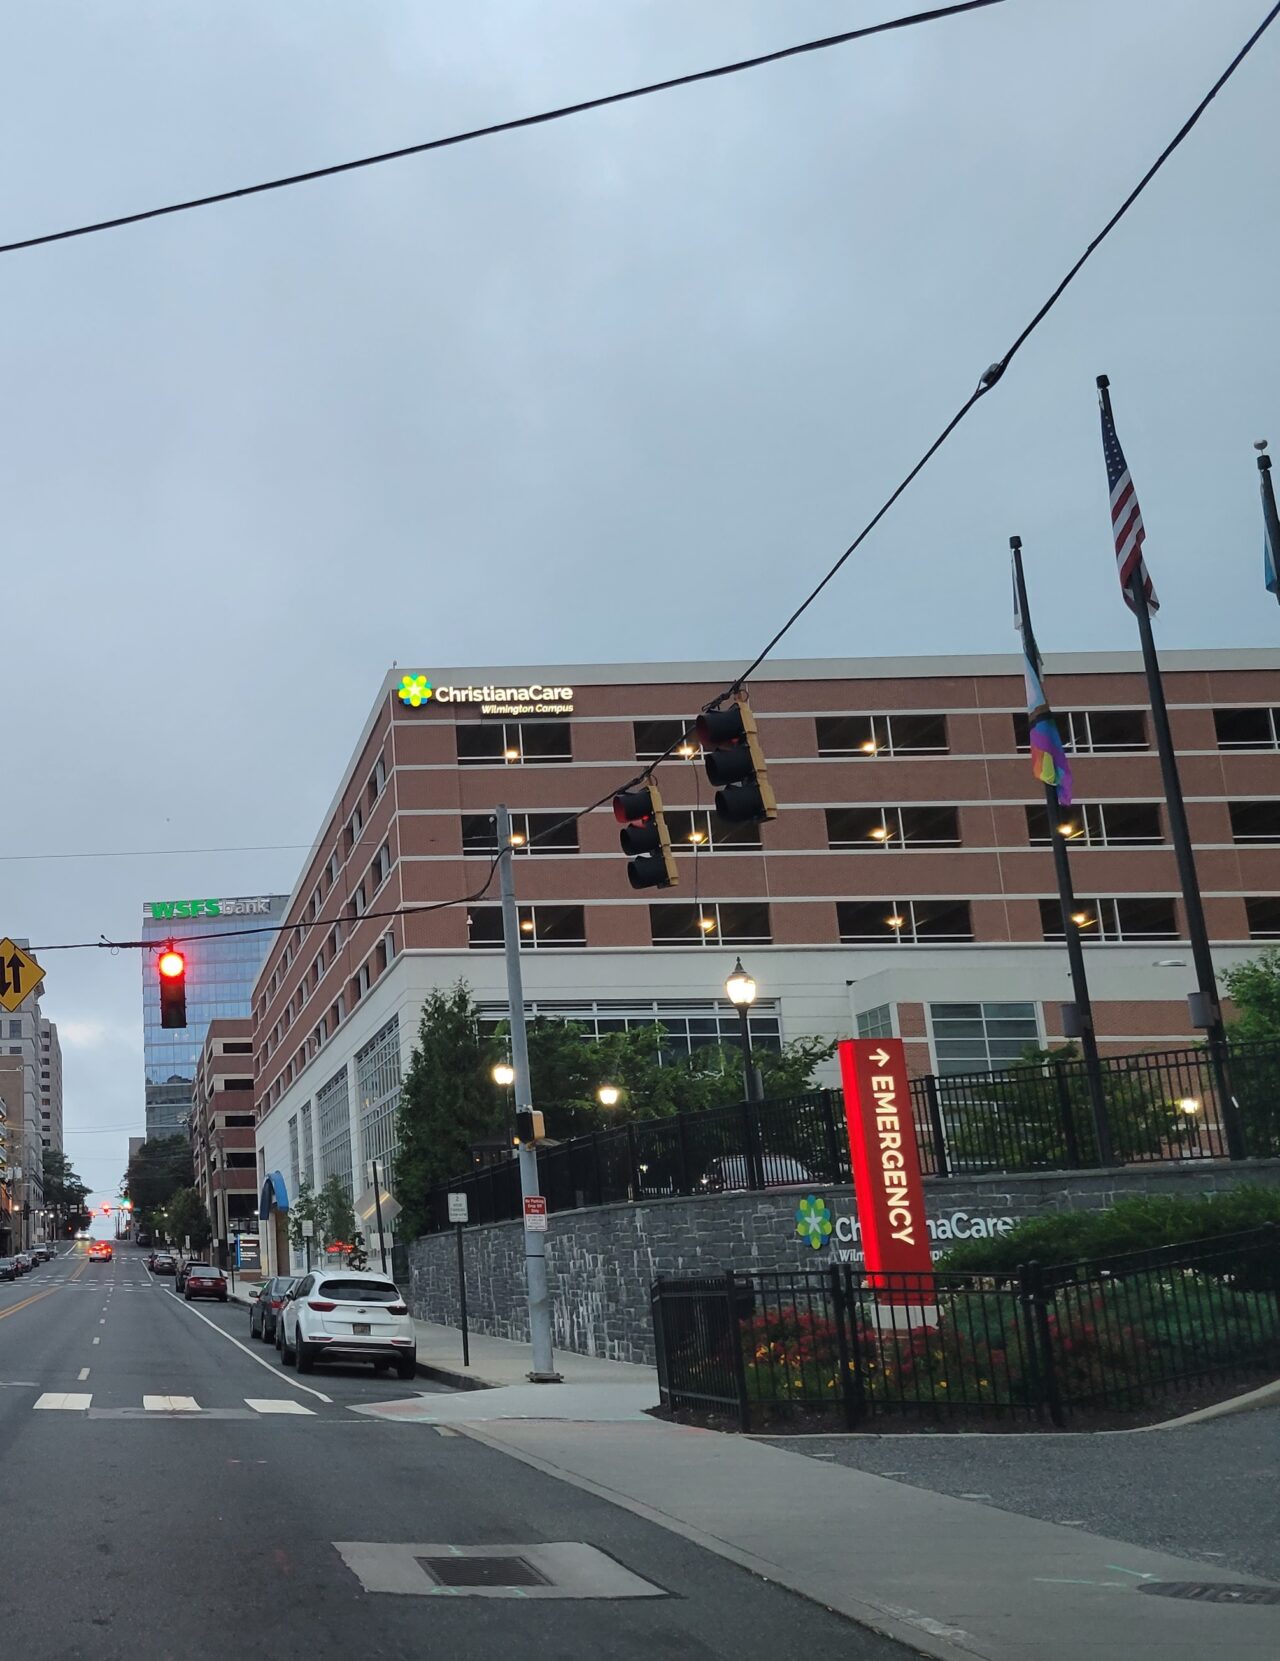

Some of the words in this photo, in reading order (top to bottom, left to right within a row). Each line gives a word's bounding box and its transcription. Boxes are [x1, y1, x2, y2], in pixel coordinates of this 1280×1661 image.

[435, 684, 573, 703] ChristianaCare
[481, 703, 534, 715] Wilmington
[535, 702, 574, 714] Campus
[150, 898, 220, 920] WSFS
[222, 897, 270, 916] bank
[871, 1075, 915, 1246] EMERGENCY
[835, 1212, 1015, 1242] ChnaCare
